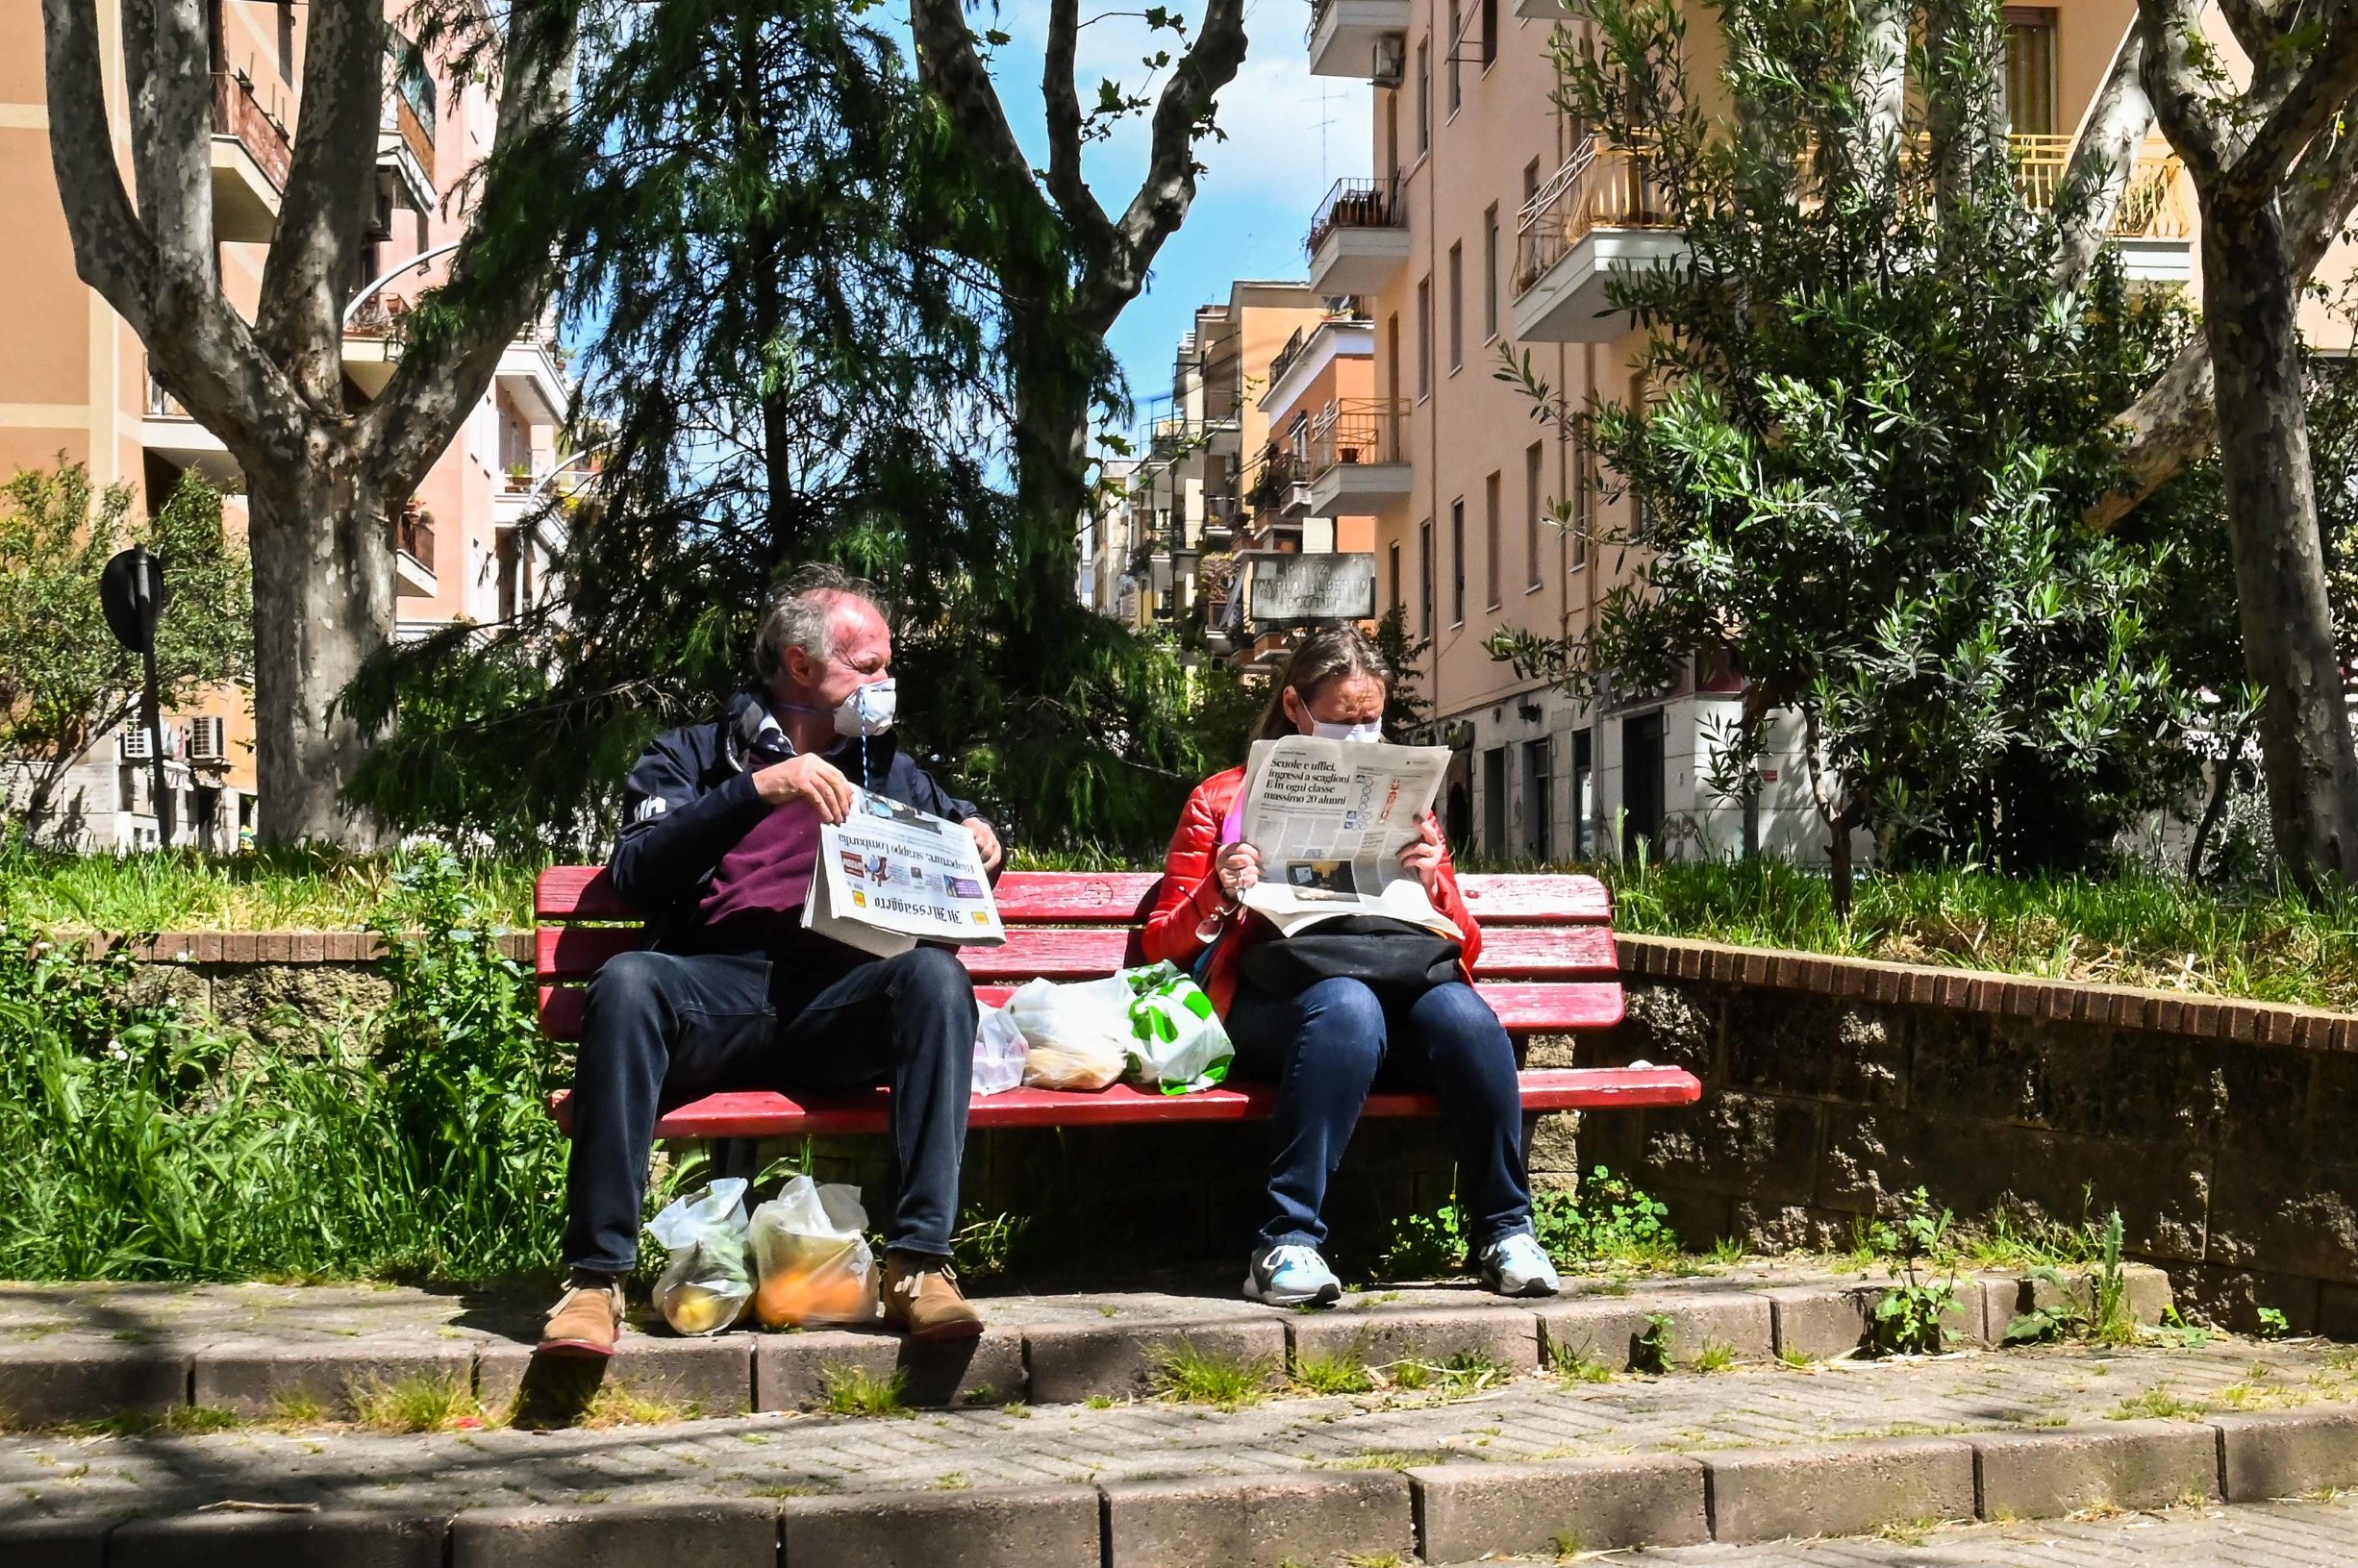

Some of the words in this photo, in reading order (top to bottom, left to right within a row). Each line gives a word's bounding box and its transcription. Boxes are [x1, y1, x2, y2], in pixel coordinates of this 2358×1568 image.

[1257, 579, 1301, 593] CARLO
[1308, 579, 1367, 592] ALBERTO
[1270, 759, 1302, 770] Scuole
[1311, 760, 1336, 772] uffici,
[1268, 768, 1303, 781] ingressi
[1312, 774, 1350, 785] scaglioni
[1266, 779, 1273, 788] E
[1274, 779, 1284, 789] in
[1286, 783, 1307, 793] ogni
[1307, 784, 1336, 794] classe
[1263, 791, 1305, 804] massimo
[1305, 794, 1317, 804] 20
[1317, 795, 1346, 806] alunni
[838, 834, 890, 855] Lombardia
[891, 845, 924, 859] strappo
[924, 854, 975, 874] Riaperture,
[874, 896, 947, 923] Messaggero
[947, 909, 963, 924] Il
